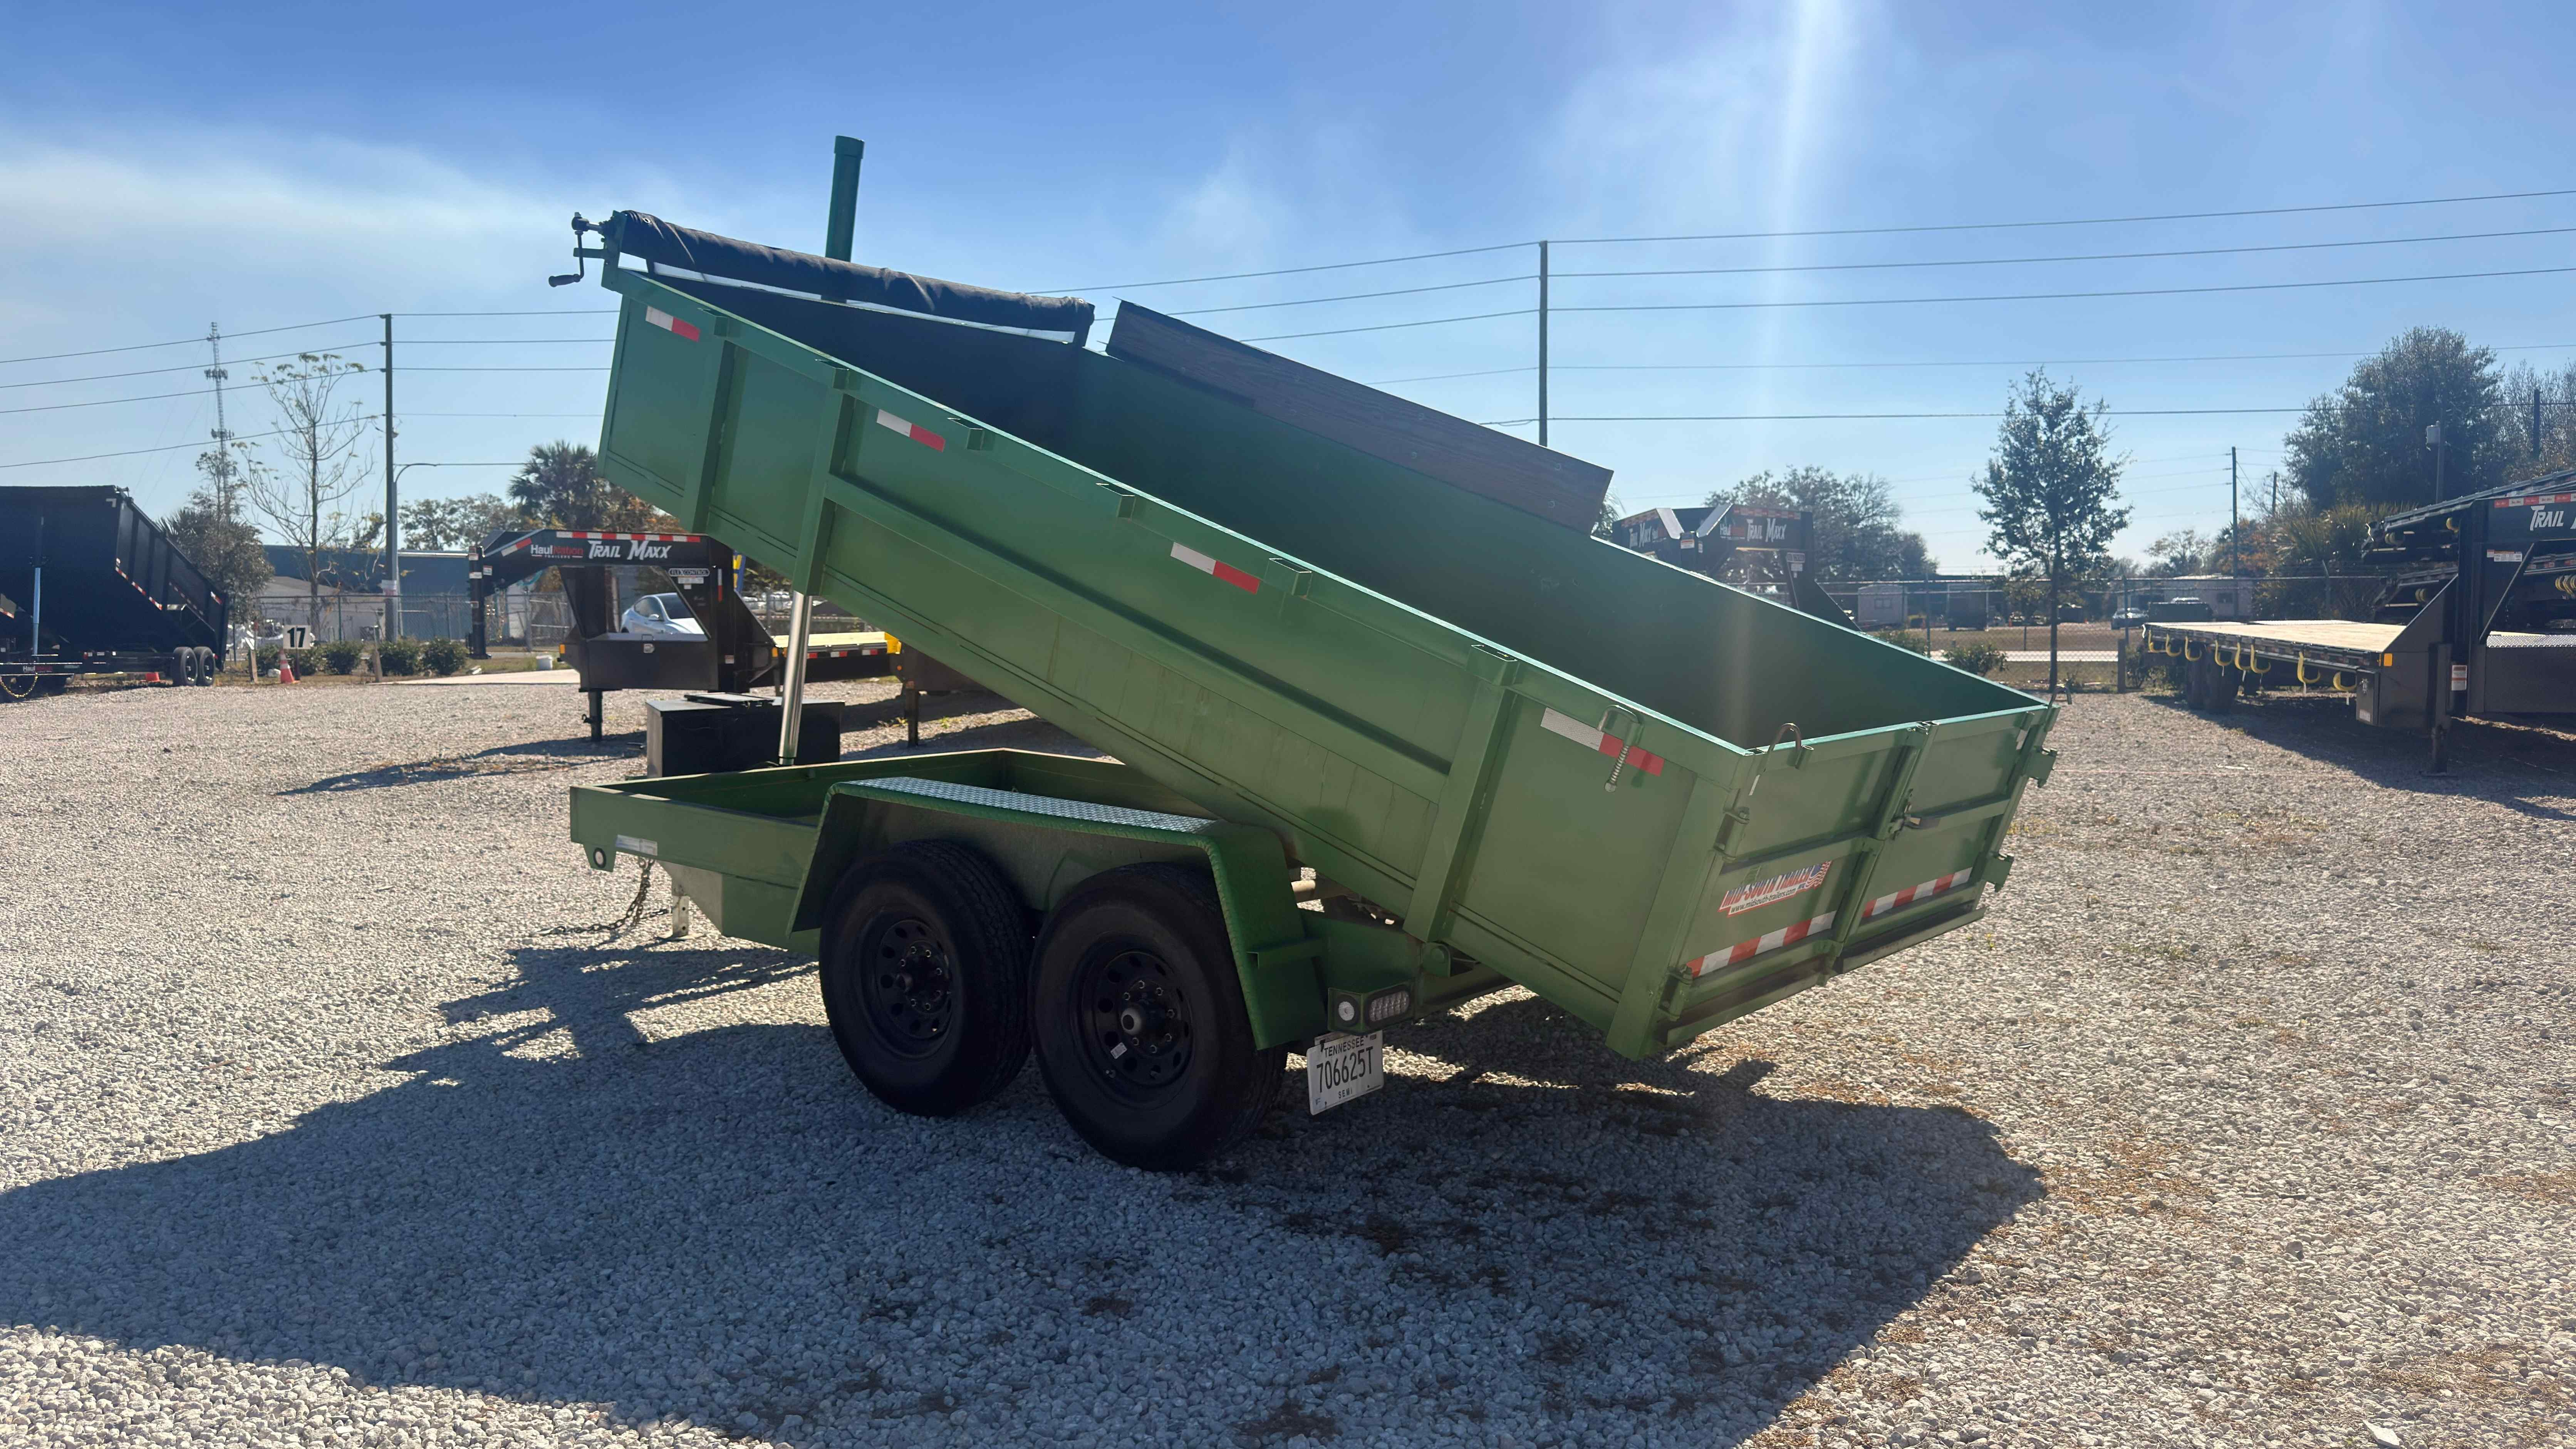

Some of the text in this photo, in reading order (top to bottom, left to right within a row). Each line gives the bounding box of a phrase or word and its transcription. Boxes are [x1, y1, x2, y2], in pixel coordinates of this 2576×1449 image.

[2529, 505, 2564, 531] TRAIL
[587, 540, 672, 560] TRAIL MAXX
[287, 627, 306, 647] 17
[1324, 1036, 1364, 1057] TENNESSEE
[1316, 1046, 1374, 1093] 706625T
